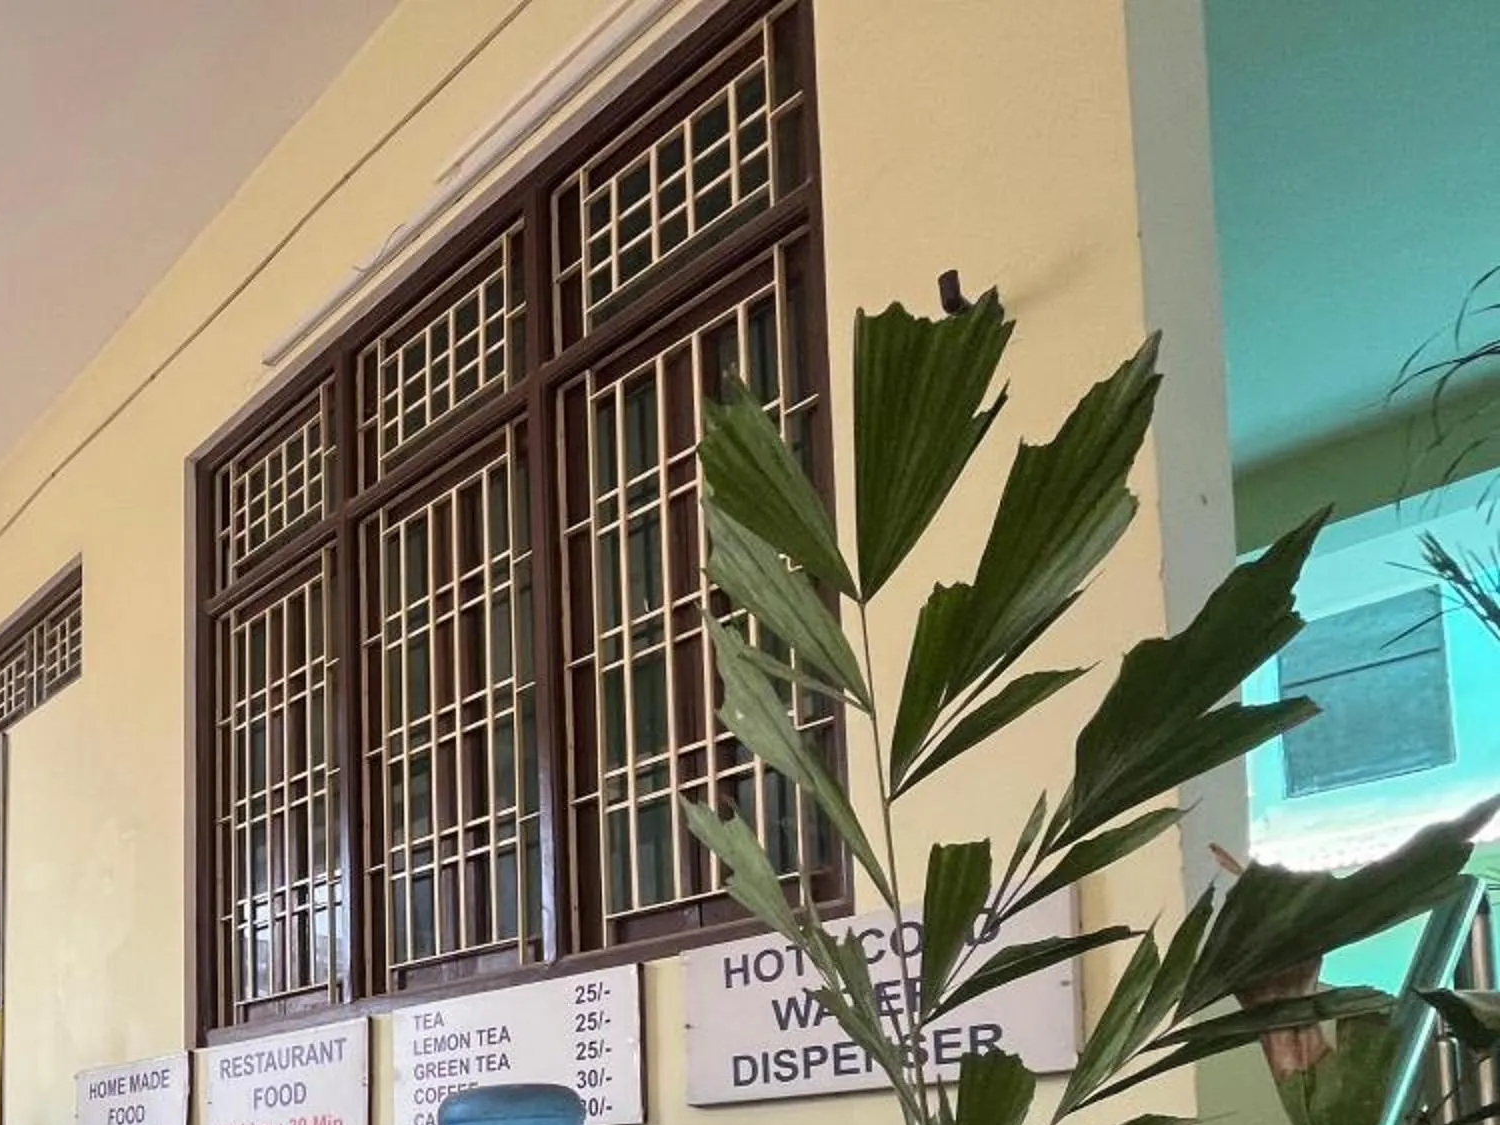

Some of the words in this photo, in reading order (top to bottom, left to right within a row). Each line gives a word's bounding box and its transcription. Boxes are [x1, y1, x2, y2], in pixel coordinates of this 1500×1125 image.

[723, 944, 806, 989] HOT
[861, 907, 1000, 964] COD
[413, 1011, 444, 1031] TEA
[575, 982, 611, 1005] 25/-
[413, 1031, 471, 1056] LEMON
[476, 1025, 511, 1047] TEA
[575, 1011, 611, 1033] 25/-
[219, 1037, 347, 1080] RESTAURANT
[413, 1057, 470, 1081] GREEN
[476, 1053, 511, 1073] TEA
[575, 1040, 612, 1062] 25/-
[732, 1023, 1003, 1088] DISPESER
[89, 1077, 126, 1100] HOME
[129, 1069, 170, 1094] MADE
[253, 1082, 307, 1111] FOOD
[577, 1067, 612, 1089] 30/-
[108, 1104, 145, 1125] FOOD
